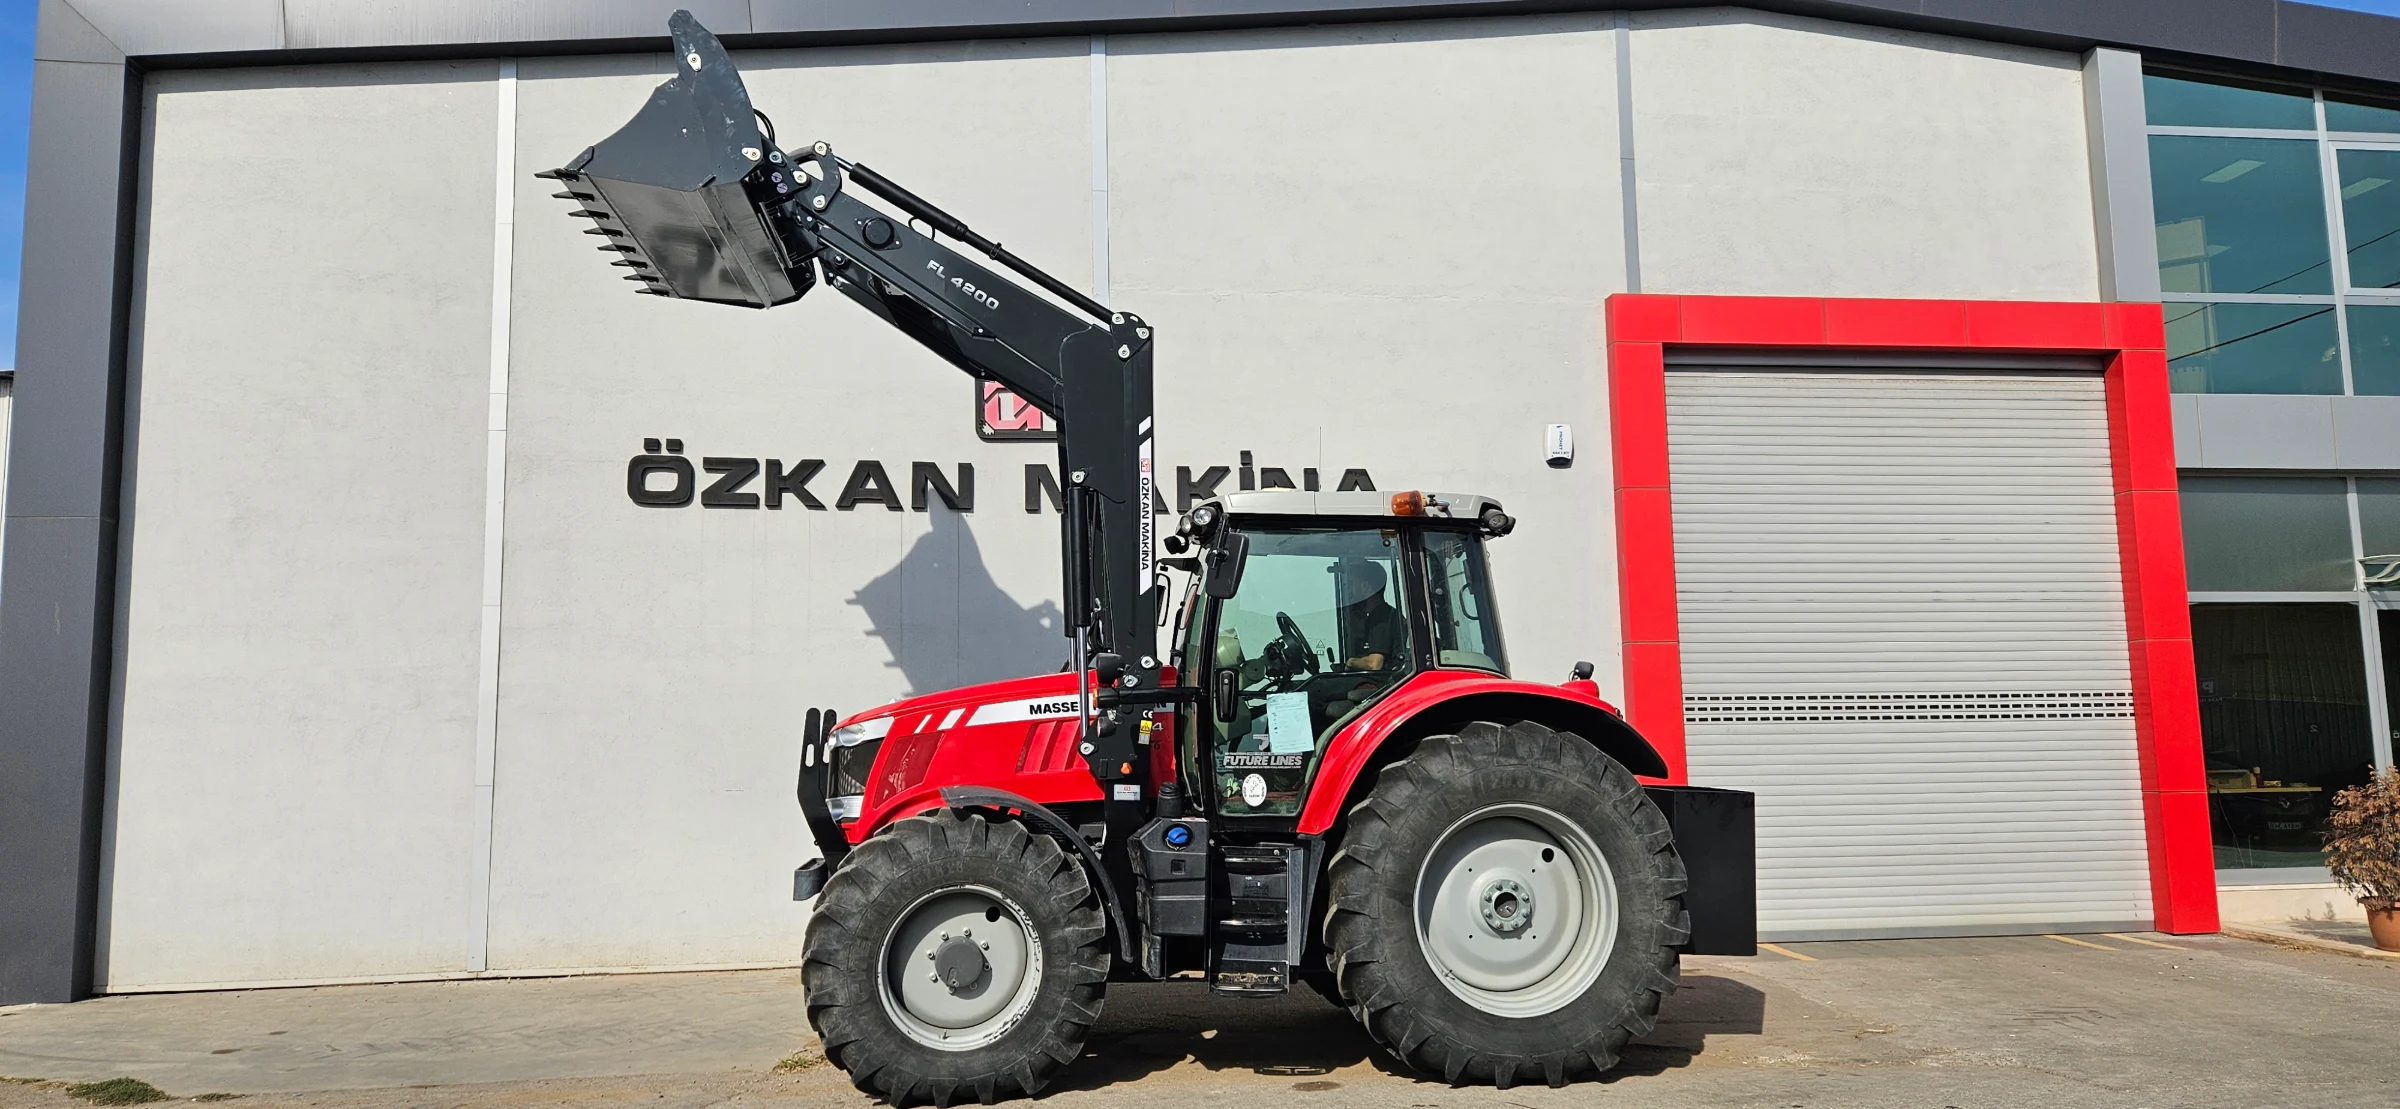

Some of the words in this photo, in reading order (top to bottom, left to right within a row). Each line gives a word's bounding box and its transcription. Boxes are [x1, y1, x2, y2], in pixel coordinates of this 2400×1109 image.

[926, 260, 945, 279] FL
[950, 278, 999, 310] 4200
[627, 438, 974, 511] ÖZKAN
[1141, 477, 1150, 519] ÖZKAN
[1141, 522, 1151, 571] MAKİNA
[1029, 701, 1080, 715] MASSE
[1223, 756, 1269, 766] FUTURE
[1270, 756, 1302, 766] LINES
